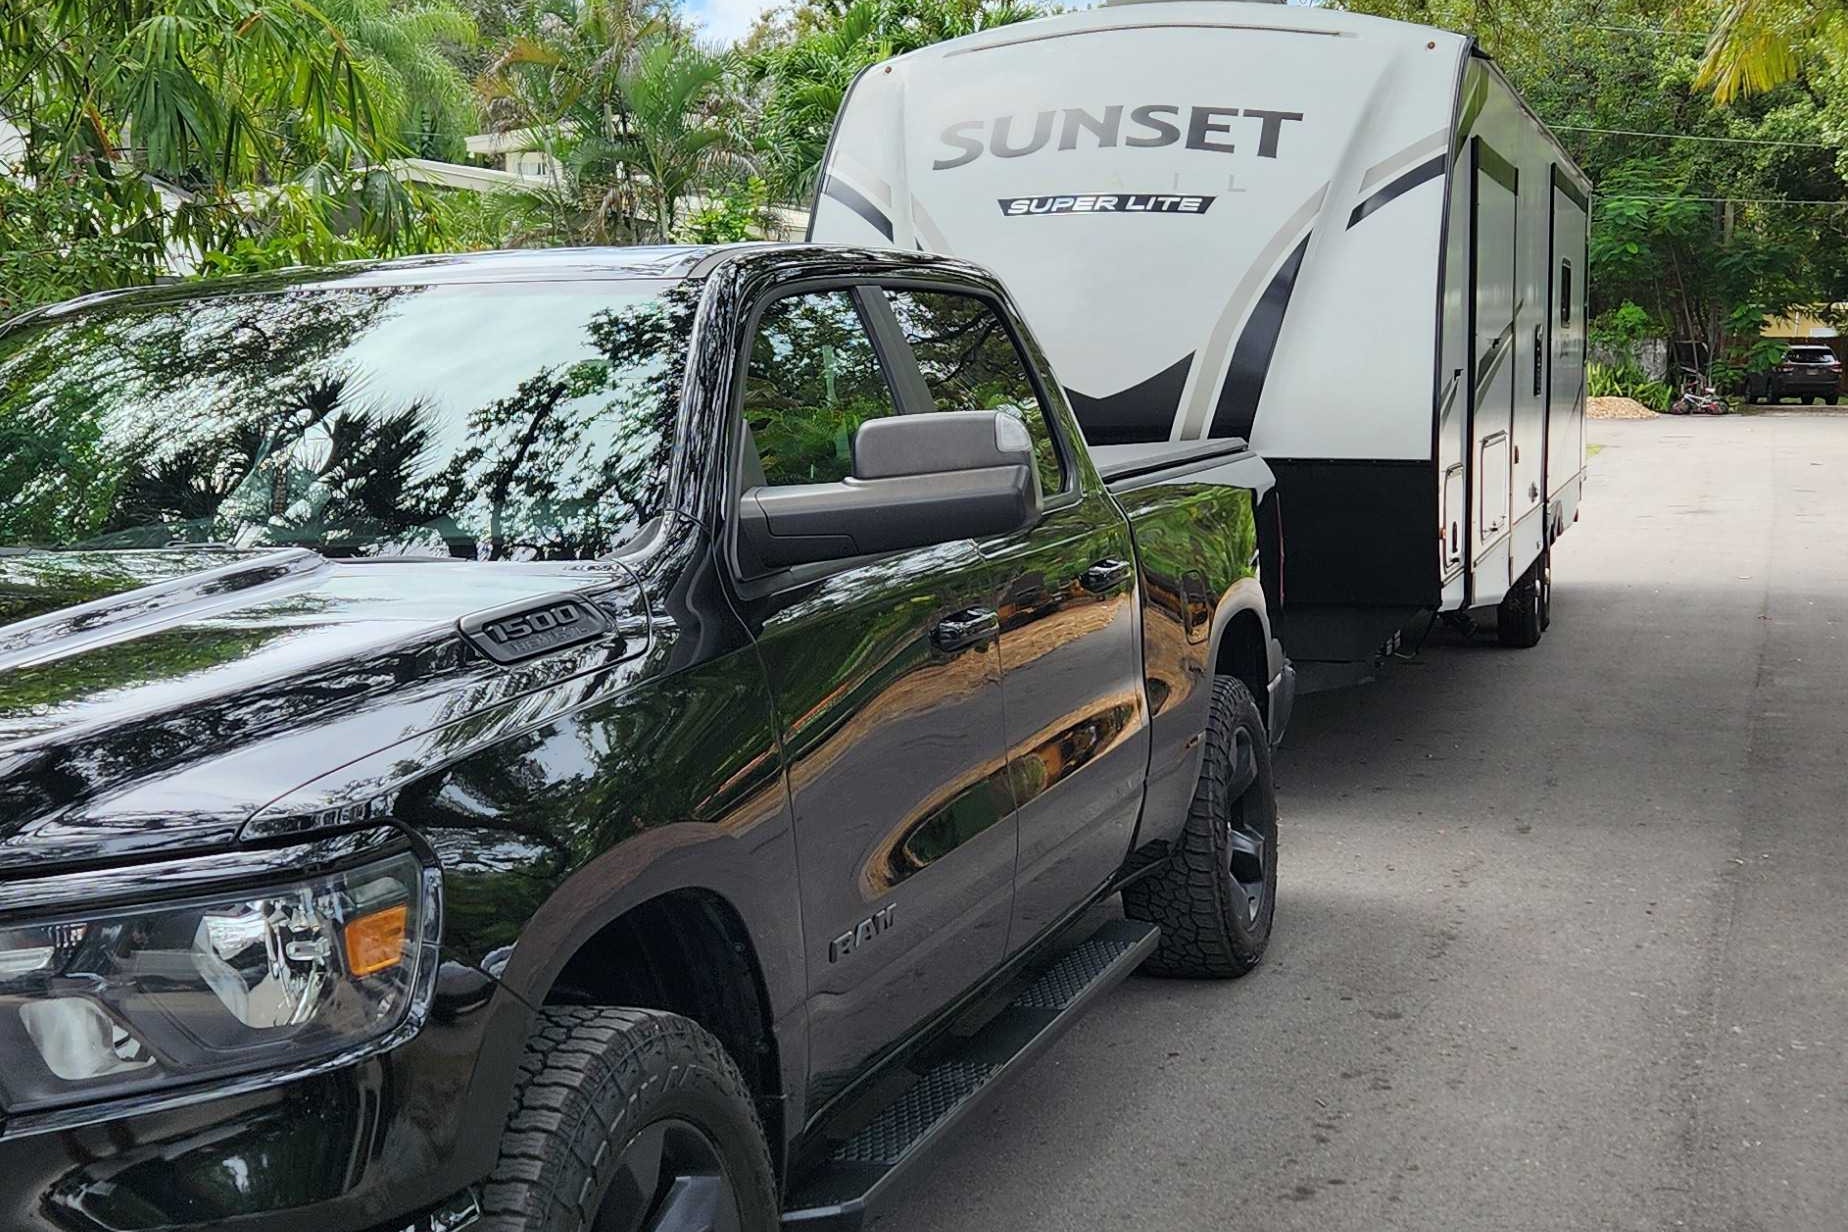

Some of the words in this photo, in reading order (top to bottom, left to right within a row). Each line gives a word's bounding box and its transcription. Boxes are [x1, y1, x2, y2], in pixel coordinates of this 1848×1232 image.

[932, 104, 1304, 171] SUNSET
[1008, 196, 1118, 213] SUPER
[1125, 196, 1203, 212] LITE
[486, 603, 580, 642] 1500
